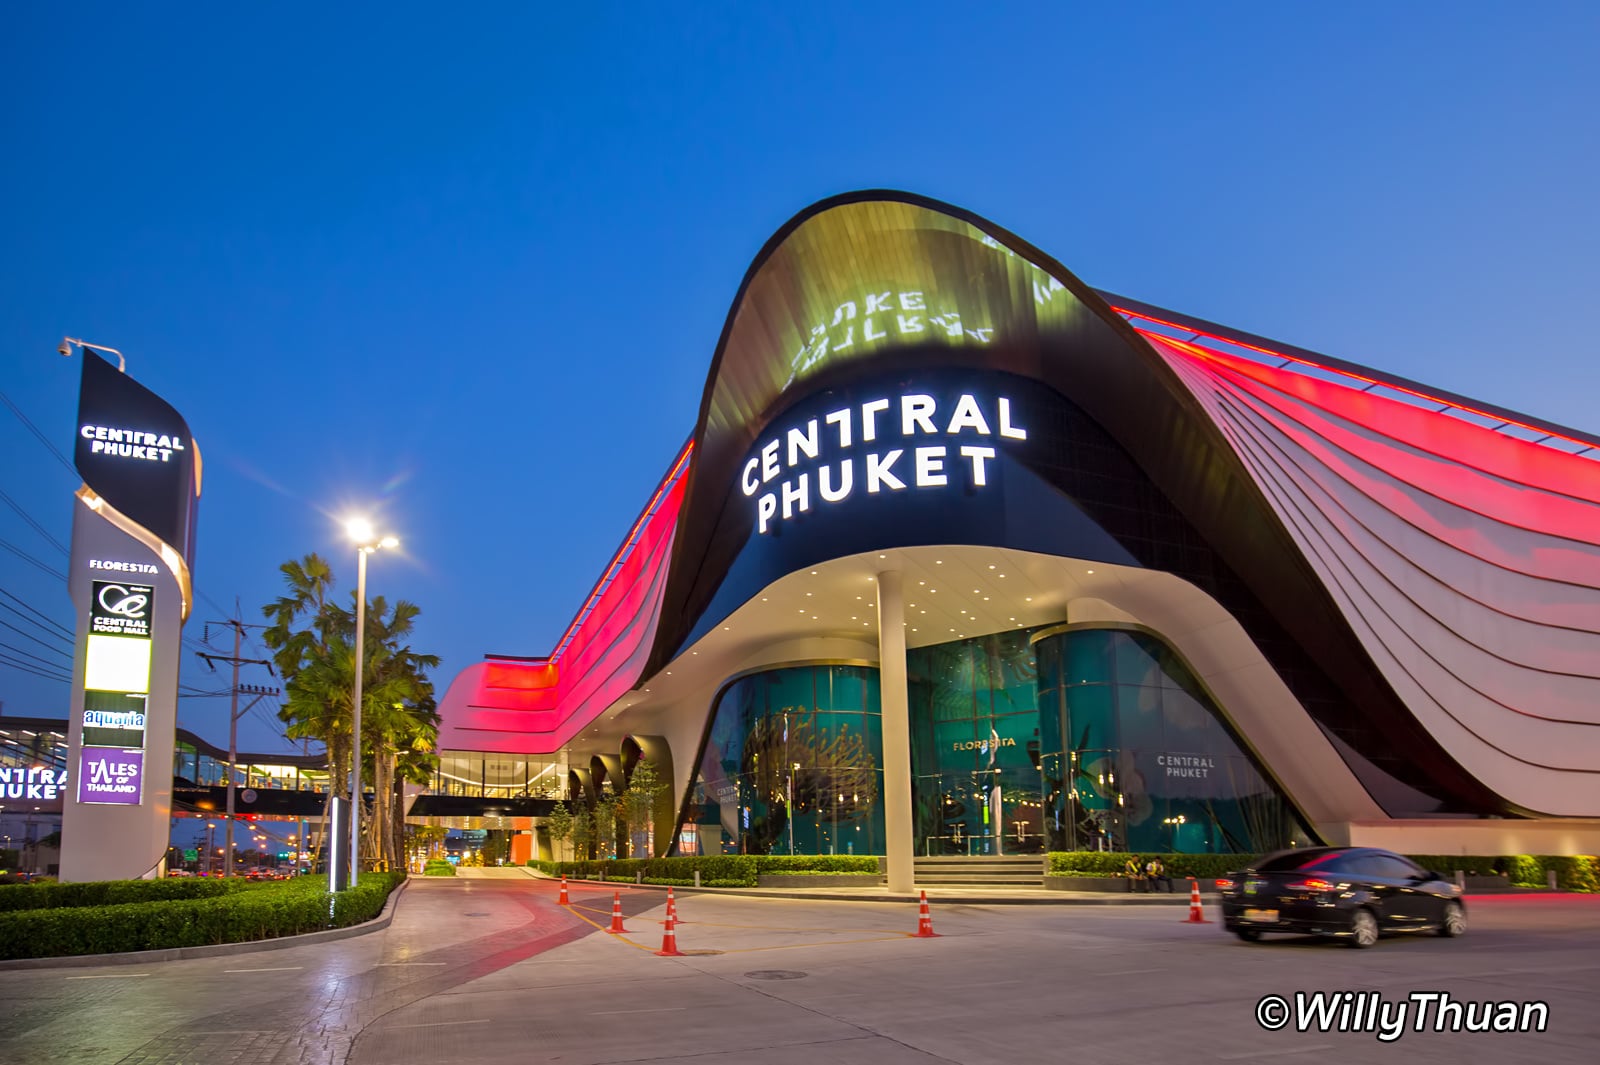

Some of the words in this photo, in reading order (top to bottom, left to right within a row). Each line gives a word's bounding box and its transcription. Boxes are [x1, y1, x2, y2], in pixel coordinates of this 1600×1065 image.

[81, 425, 184, 450] CENTRAL
[92, 441, 172, 462] PHUKET
[742, 394, 1027, 496] CENTRAL
[758, 446, 996, 534] PHUKET
[90, 560, 158, 574] FLORESTA
[94, 617, 148, 628] CENTRAL
[94, 625, 121, 633] FOOD
[1157, 755, 1215, 768] CENTRAL
[0, 768, 68, 785] NTRA
[87, 759, 138, 784] TALES
[1166, 767, 1208, 778] PHUKET
[115, 776, 130, 784] OF
[86, 783, 137, 793] THAILAND
